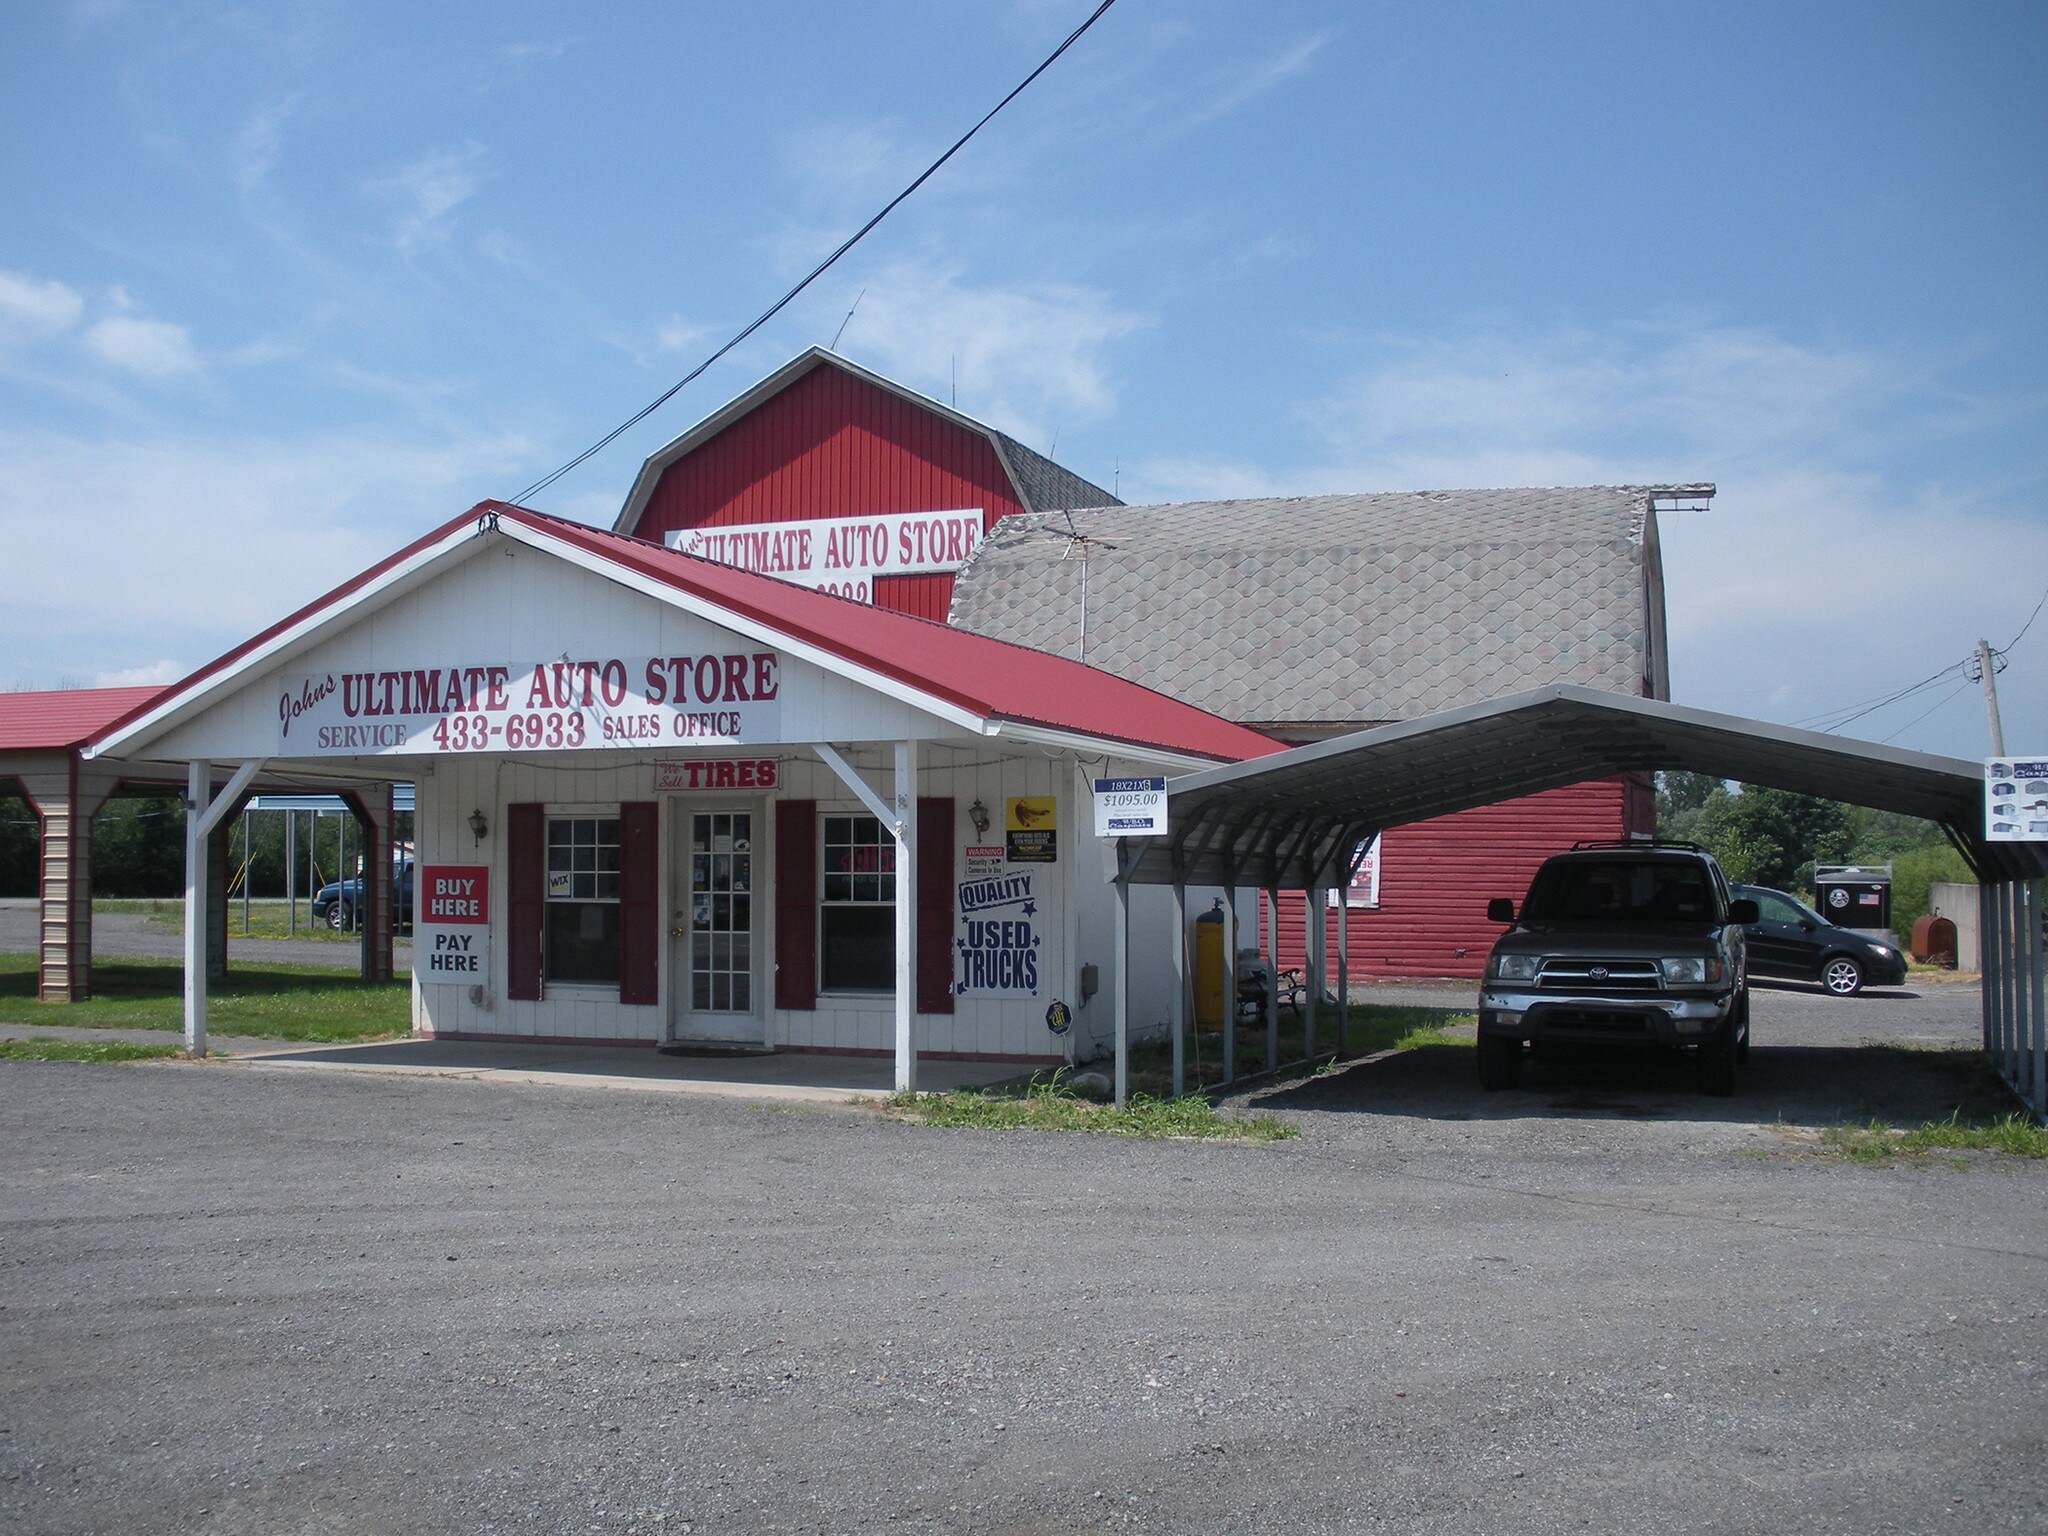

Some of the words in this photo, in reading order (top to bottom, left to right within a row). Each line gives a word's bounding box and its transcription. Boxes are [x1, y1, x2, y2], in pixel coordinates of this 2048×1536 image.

[704, 531, 813, 572] ULTIMATE
[824, 523, 889, 569] AUTO
[899, 518, 979, 565] STORE
[279, 674, 337, 737] Johns
[341, 667, 509, 718] ULTIMATE
[527, 659, 626, 710] AUTO
[646, 653, 779, 704] STORE
[317, 724, 407, 748] SERVICE
[433, 713, 585, 750] 433-6933
[603, 714, 660, 739] SALES
[673, 712, 741, 736] OFFICE
[660, 763, 678, 774] We
[684, 761, 775, 787] TIRES
[659, 776, 683, 787] Sell
[1103, 793, 1158, 807] $1095.00
[968, 848, 1003, 856] WARNING
[968, 858, 987, 866] Security
[436, 879, 474, 896] BUY
[551, 875, 568, 887] WIX
[963, 876, 1031, 907] QUALITY
[431, 899, 479, 917] HERE
[436, 934, 473, 951] PAY
[968, 921, 1031, 949] USED
[430, 954, 478, 972] HERE
[961, 949, 1037, 989] TRUCKS
